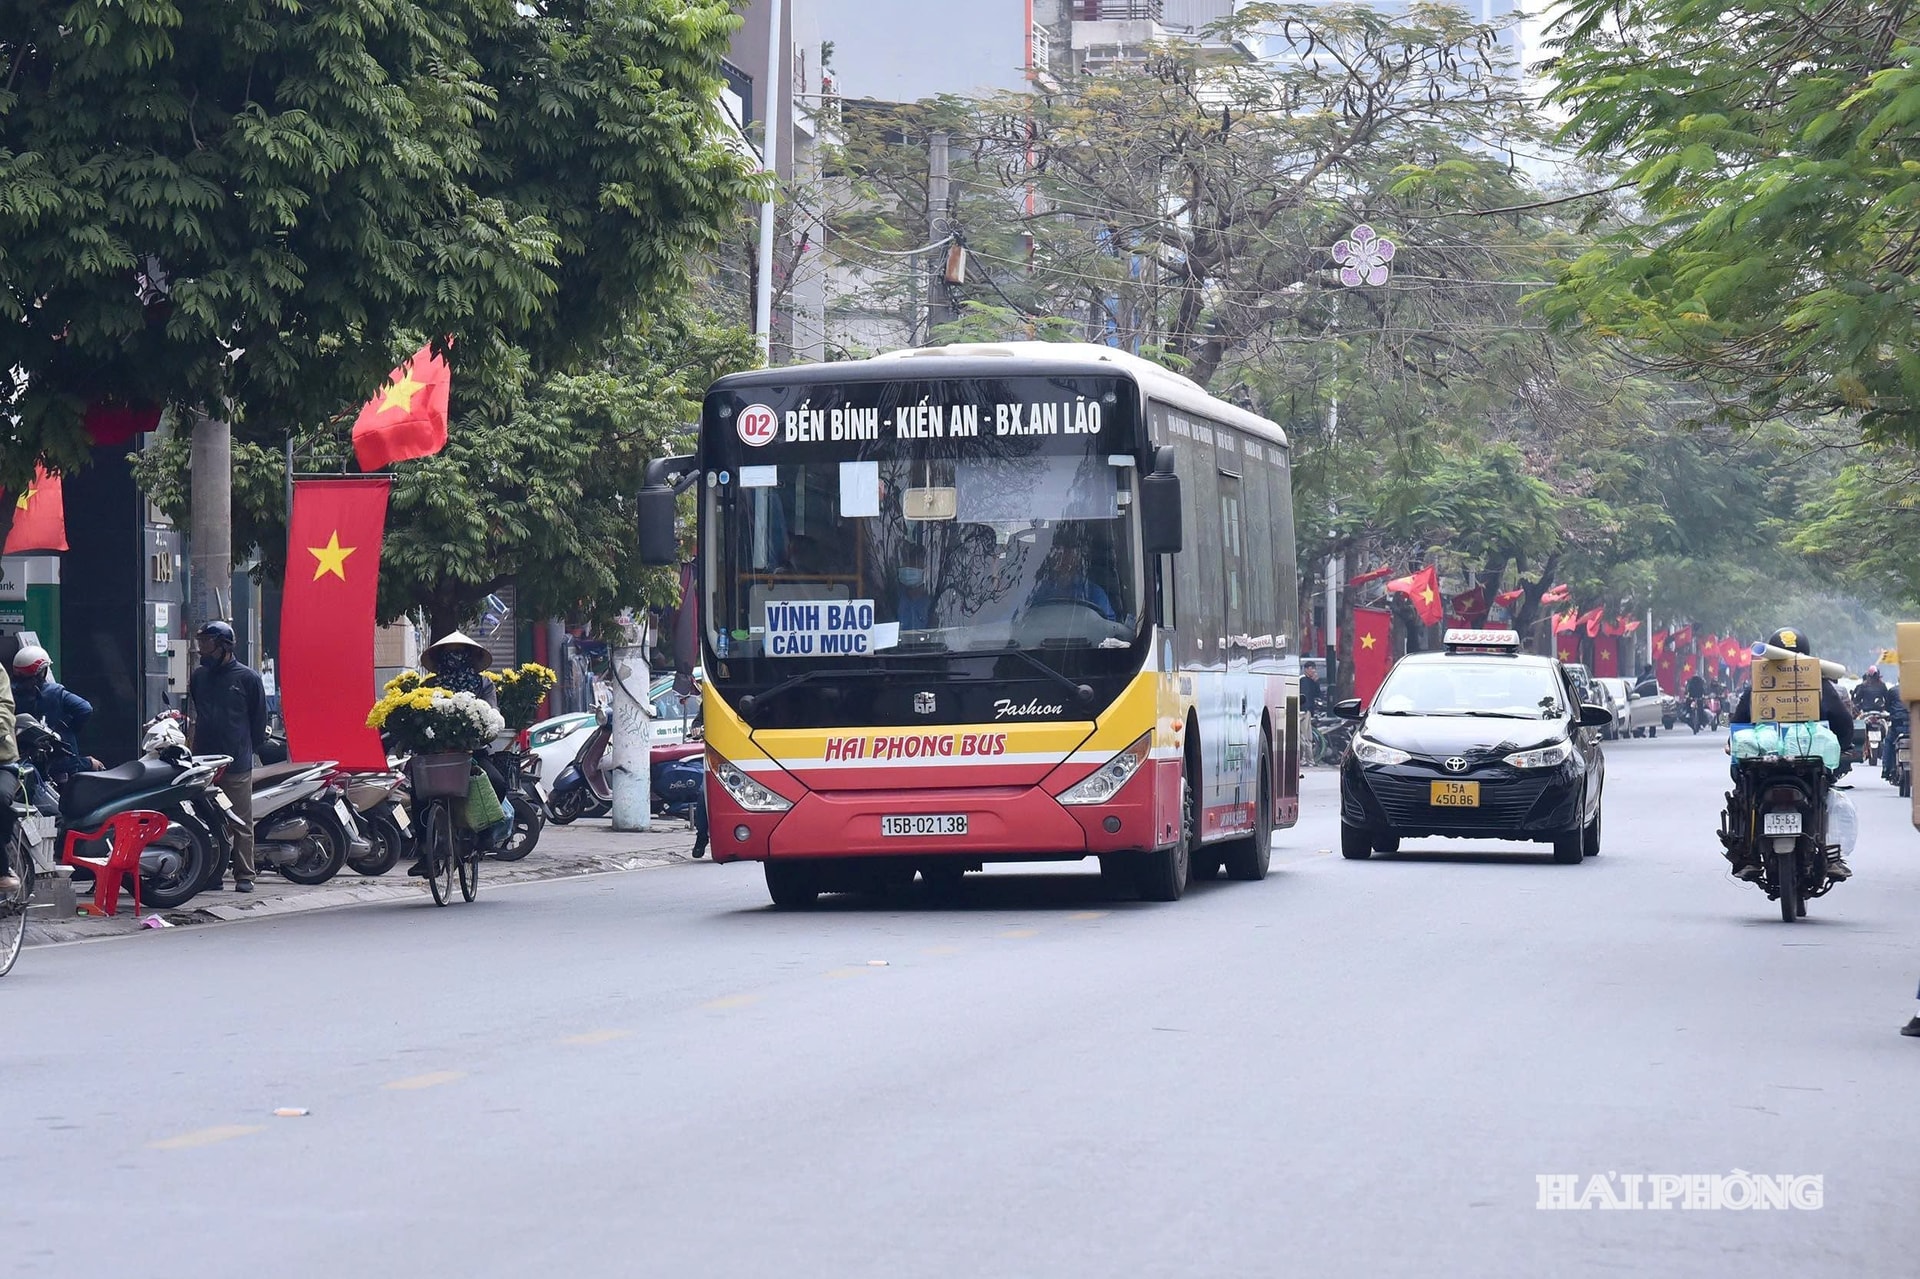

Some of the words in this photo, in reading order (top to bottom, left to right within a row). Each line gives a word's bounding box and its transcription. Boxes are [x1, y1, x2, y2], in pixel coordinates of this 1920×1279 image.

[745, 413, 770, 437] 02
[785, 399, 825, 442] BẾN
[830, 402, 878, 441] BÍNH
[896, 395, 943, 438] KIẾN
[949, 404, 978, 437] AN
[996, 402, 1057, 436] BX.AN
[1063, 395, 1101, 434] LÃO
[0, 581, 15, 591] nk
[767, 601, 819, 632] VĨNH
[828, 600, 872, 631] BẢO
[993, 698, 1063, 720] Fashion
[825, 736, 867, 762] HAI
[872, 735, 954, 761] PHONG
[960, 733, 1007, 757] BUS
[1435, 794, 1474, 805] 450.86
[1445, 783, 1465, 794] 15A
[886, 816, 965, 834] 15B-021.38
